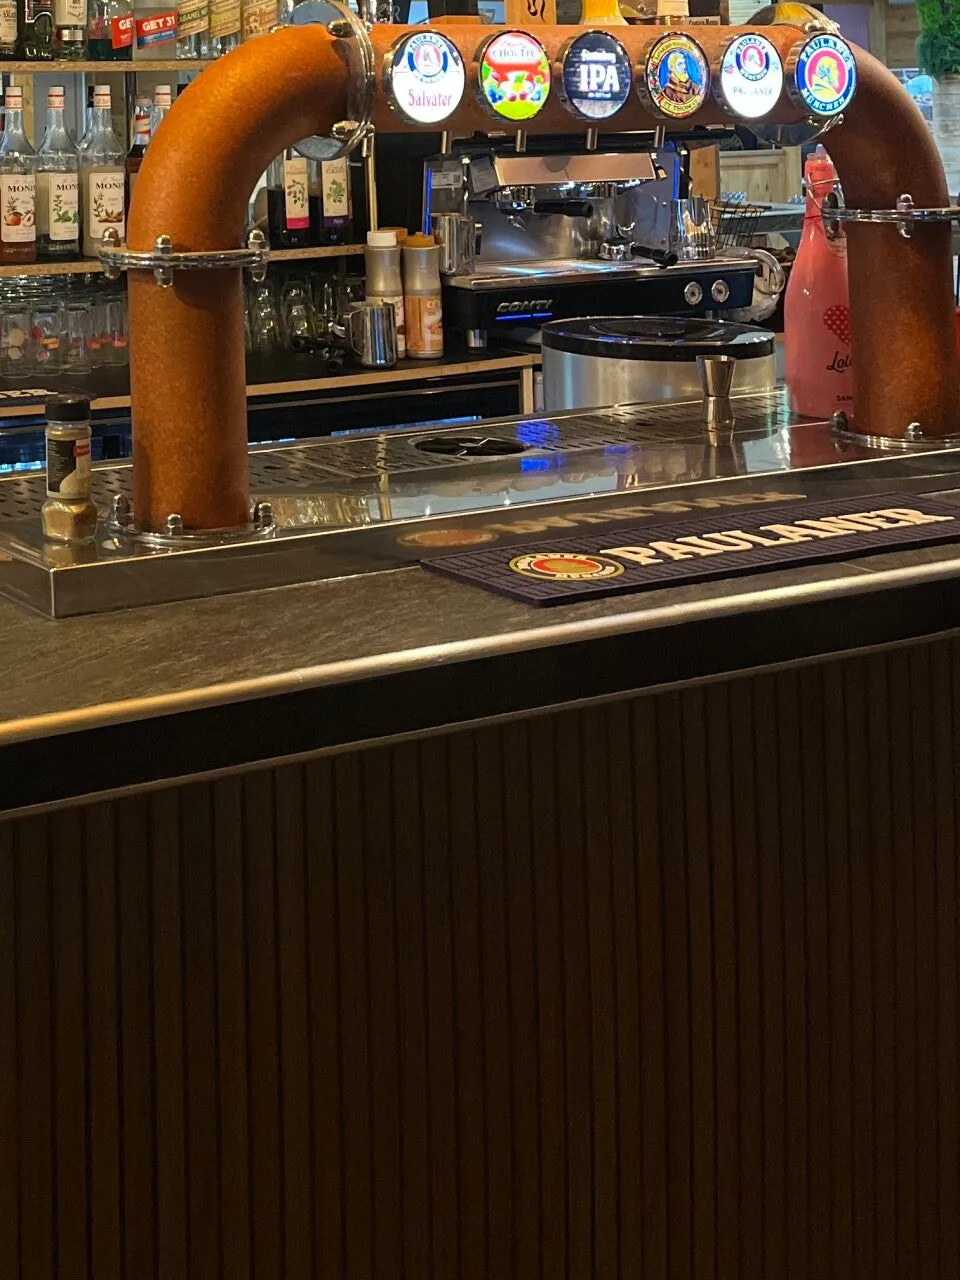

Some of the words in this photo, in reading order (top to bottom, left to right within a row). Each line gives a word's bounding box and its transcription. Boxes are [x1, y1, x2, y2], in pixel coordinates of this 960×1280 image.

[141, 17, 166, 32] GET
[165, 15, 176, 27] 31
[802, 37, 853, 68] PAULANER
[579, 64, 621, 93] IPA
[407, 88, 453, 107] Salvator
[801, 87, 845, 111] MÜNCHEN
[495, 299, 554, 314] CONTI
[599, 507, 956, 566] PAULANER
